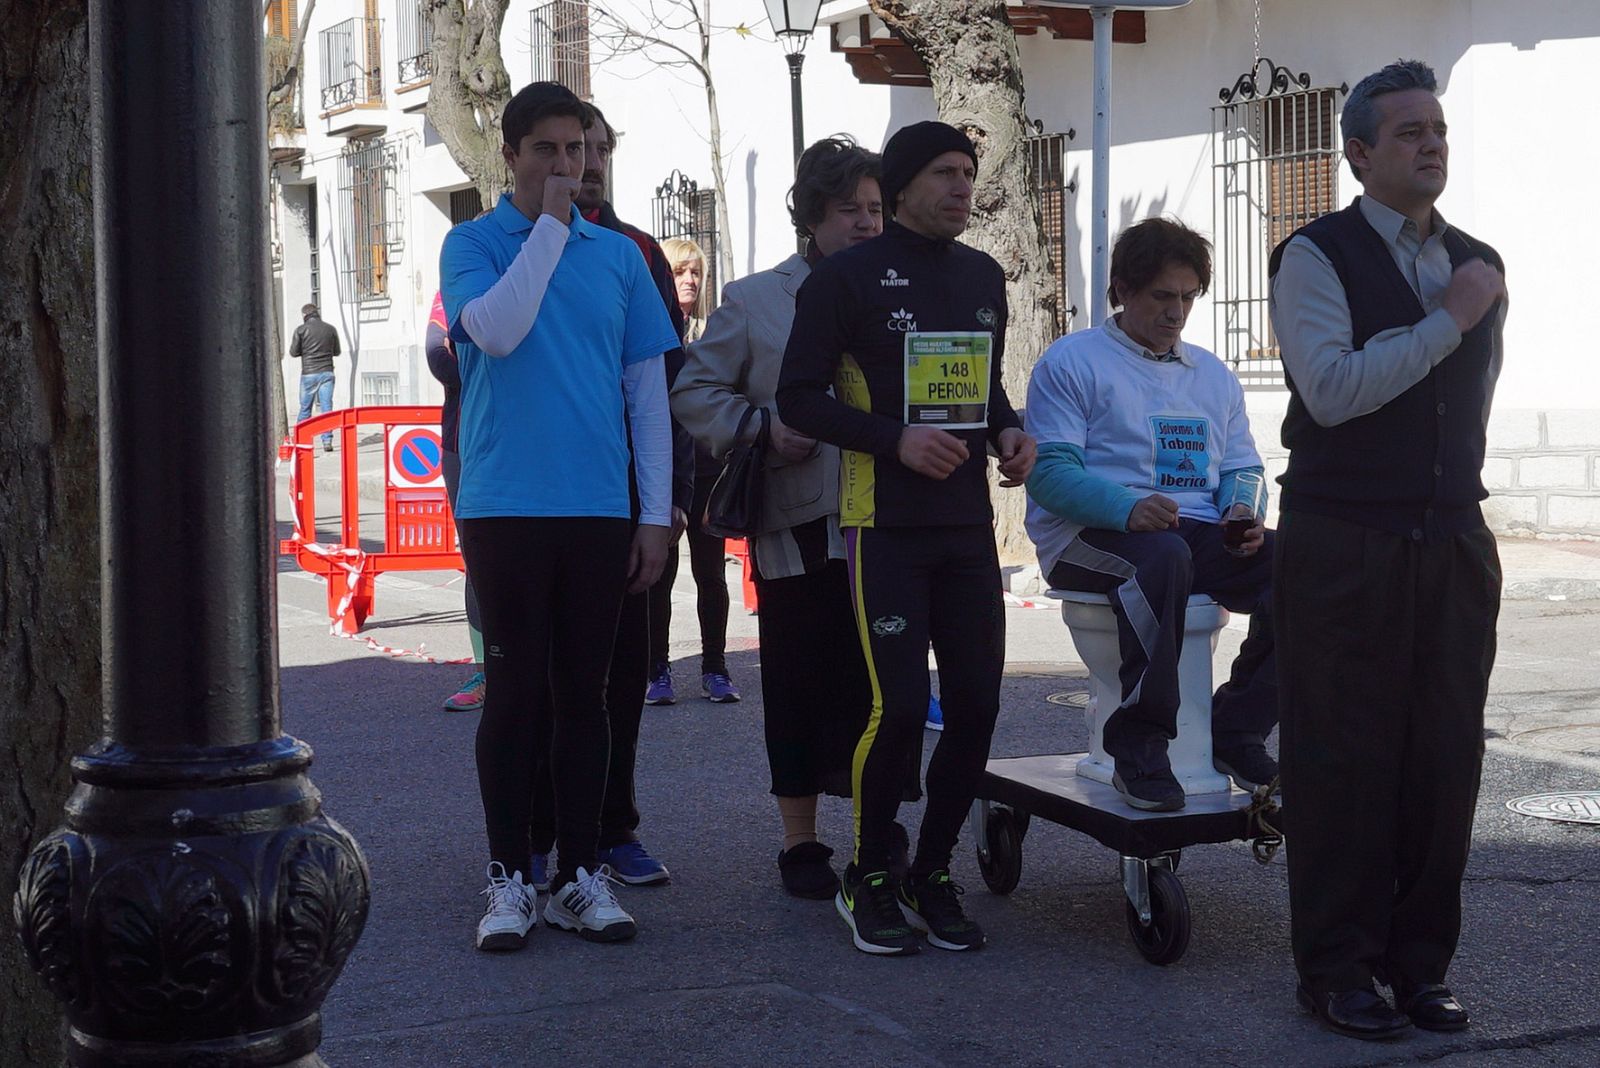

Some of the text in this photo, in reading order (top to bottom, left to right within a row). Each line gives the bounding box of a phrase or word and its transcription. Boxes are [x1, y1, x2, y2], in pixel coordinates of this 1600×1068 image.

[880, 279, 909, 287] VIATOR
[887, 320, 917, 331] CCM
[940, 362, 969, 378] 148
[928, 382, 979, 399] PERONA
[1159, 422, 1194, 435] Salvemos
[1158, 438, 1204, 452] Tabano
[1161, 473, 1206, 487] Iberico
